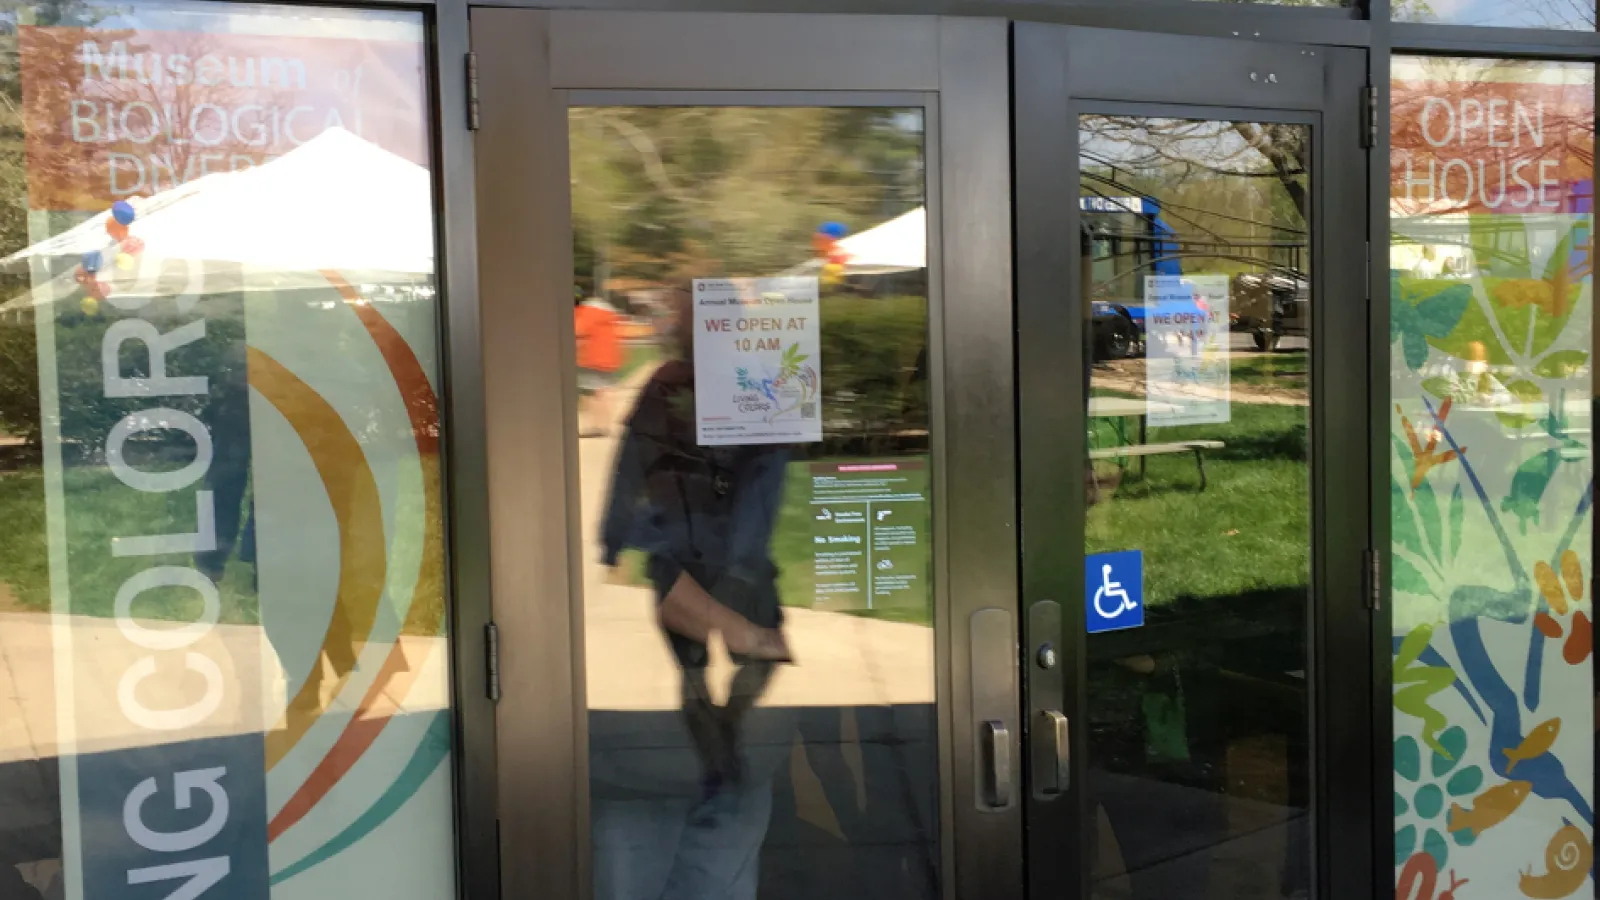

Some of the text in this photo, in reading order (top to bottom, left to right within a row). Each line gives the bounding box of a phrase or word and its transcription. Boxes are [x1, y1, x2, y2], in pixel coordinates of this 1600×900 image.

[81, 40, 307, 88] Museum
[1421, 97, 1544, 148] OPEN
[1405, 156, 1560, 208] HOUSE
[704, 316, 809, 333] WE OPEN AT
[734, 337, 781, 352] 10 AM
[102, 244, 225, 731] COLORS
